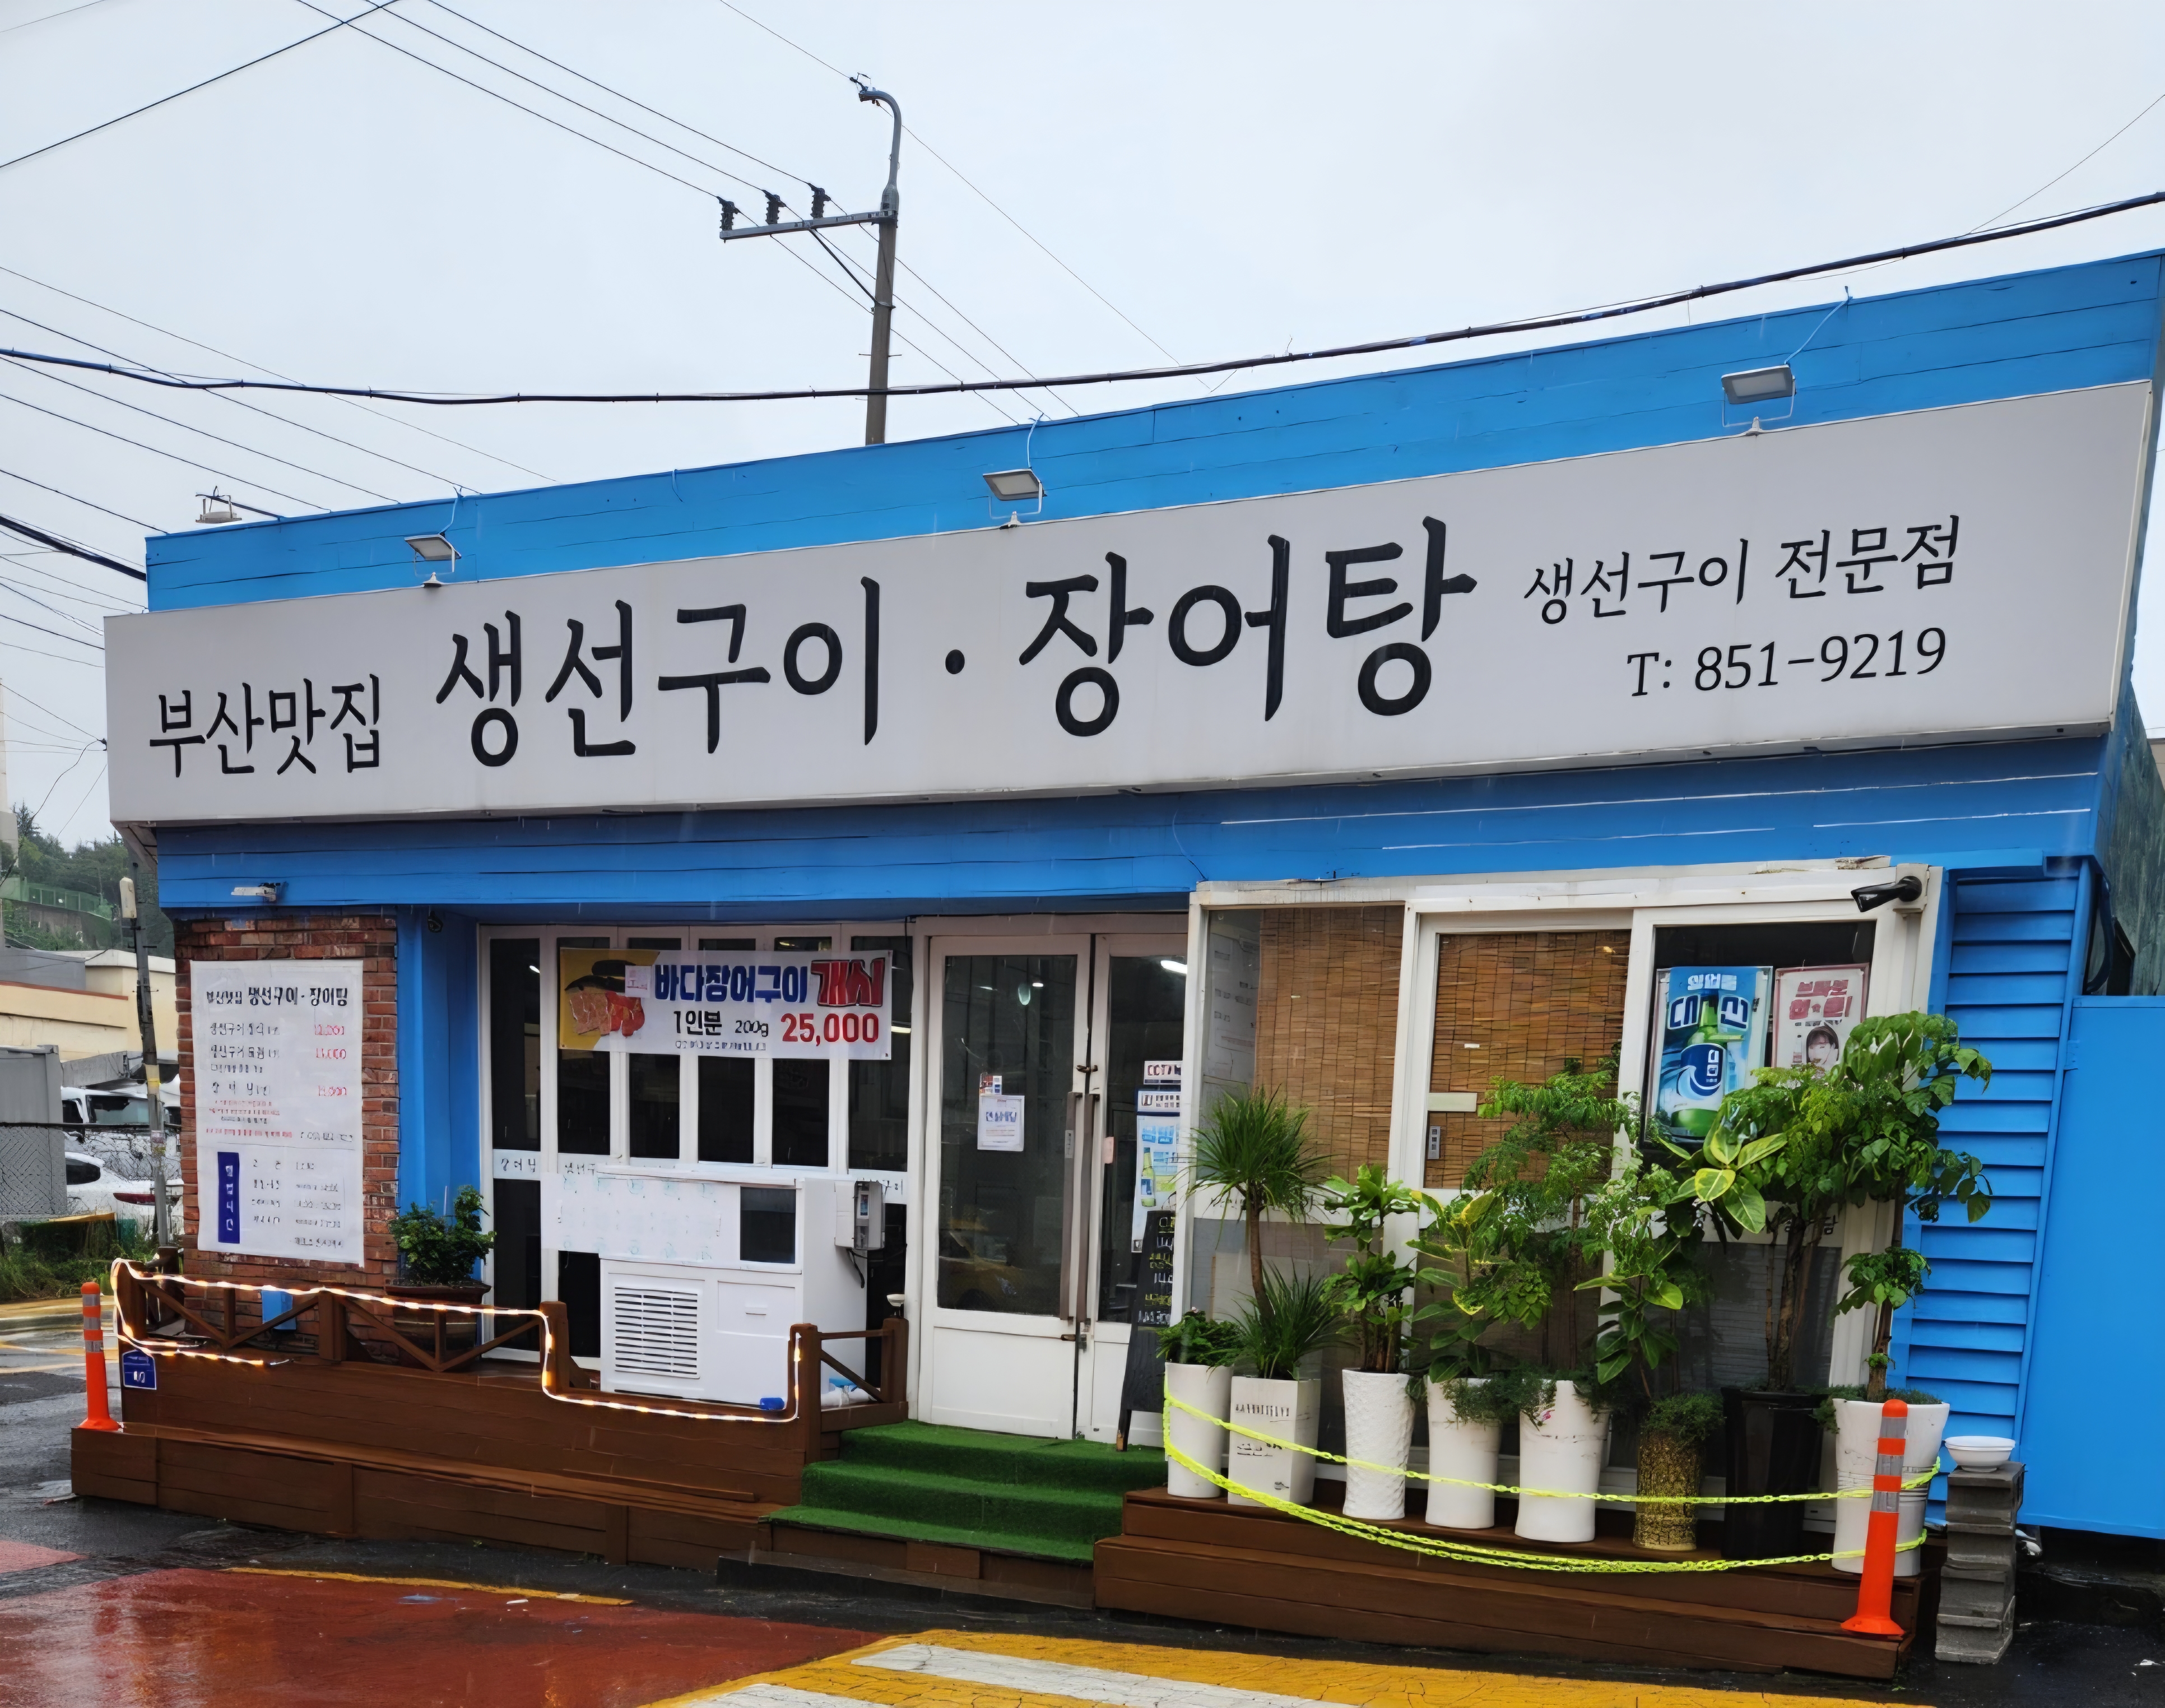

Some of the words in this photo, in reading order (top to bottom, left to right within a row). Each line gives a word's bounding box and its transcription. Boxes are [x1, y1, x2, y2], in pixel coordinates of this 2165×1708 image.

[1524, 539, 1749, 624] 생선구이
[1775, 515, 1959, 598] 전문점
[436, 577, 880, 767] 생선구이
[1019, 516, 1478, 736] 장어탕
[1627, 652, 1672, 697] T:
[1695, 627, 1946, 691] 851-9219
[150, 674, 379, 778] 부산맛집
[654, 964, 808, 1004] 바다장어구이
[673, 1010, 722, 1036] 1인분
[735, 1020, 769, 1037] 200g
[780, 1013, 879, 1047] 25,000
